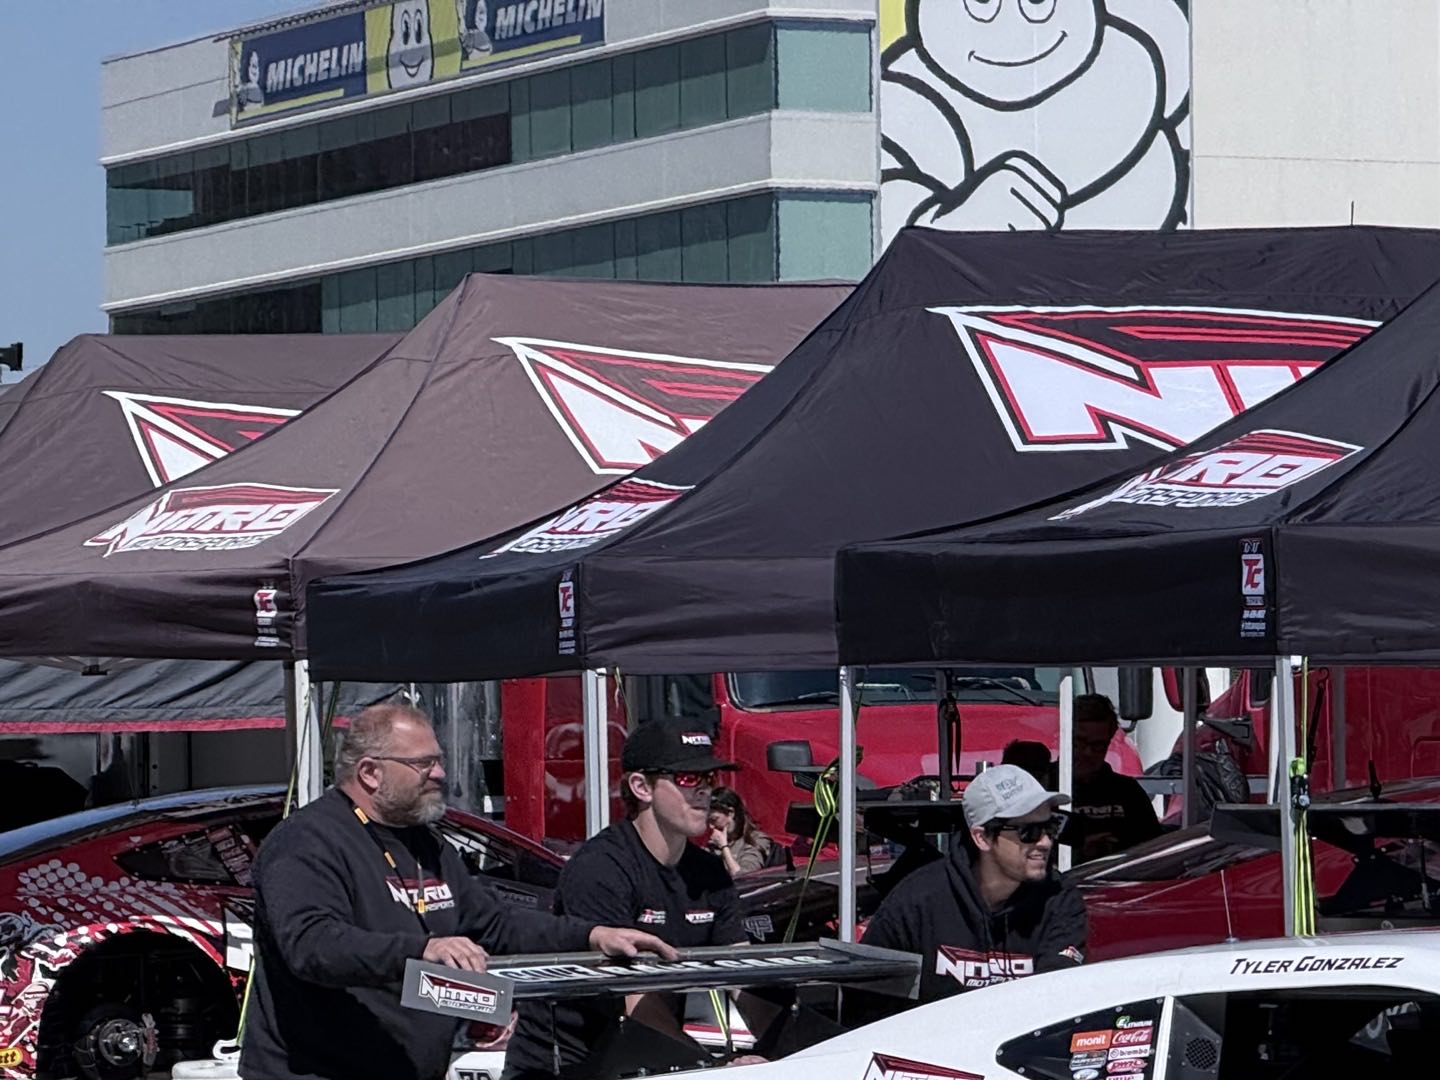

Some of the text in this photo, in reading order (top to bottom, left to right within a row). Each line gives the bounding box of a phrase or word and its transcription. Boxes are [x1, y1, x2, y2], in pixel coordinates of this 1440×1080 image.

[495, 0, 601, 40] MICHELIN
[265, 42, 364, 93] MICHELIN
[722, 955, 834, 970] CARS
[1230, 956, 1405, 975] TYLER GONZALEZ
[1076, 1034, 1107, 1047] monit
